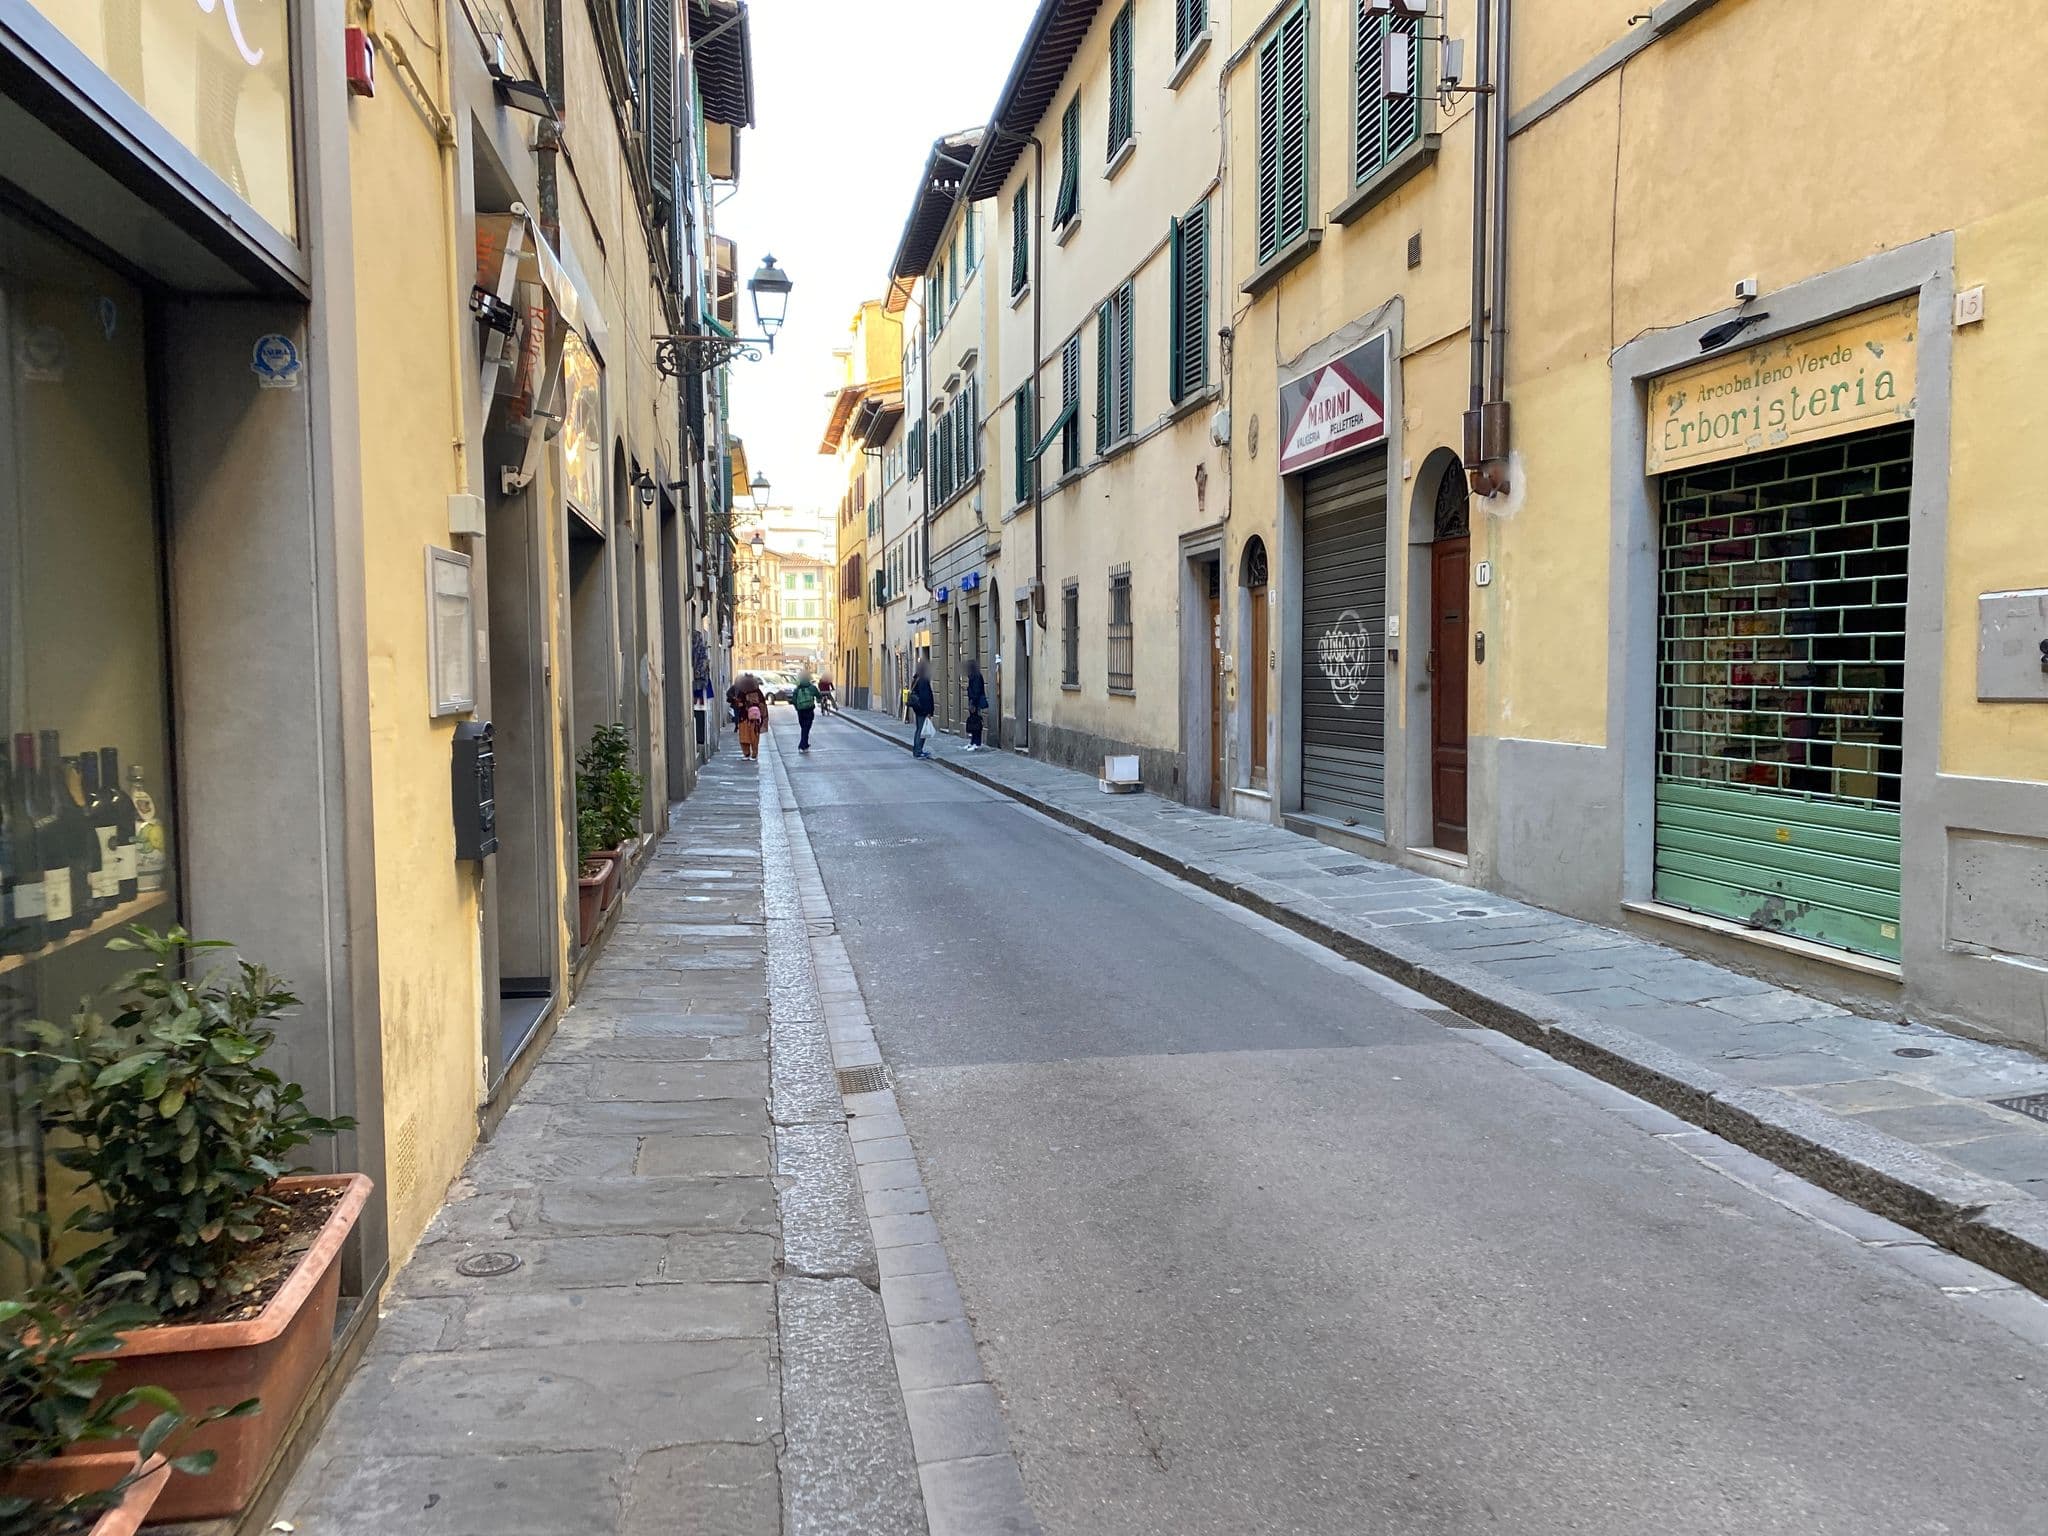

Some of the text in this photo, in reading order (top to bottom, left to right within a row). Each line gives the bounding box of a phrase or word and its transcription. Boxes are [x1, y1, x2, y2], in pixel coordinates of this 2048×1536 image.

[1697, 344, 1853, 402] Arcobaleno Verde
[1308, 389, 1350, 428] MARINI
[1330, 413, 1364, 436] PELLETTERIA
[1664, 368, 1896, 451] Erboristeria
